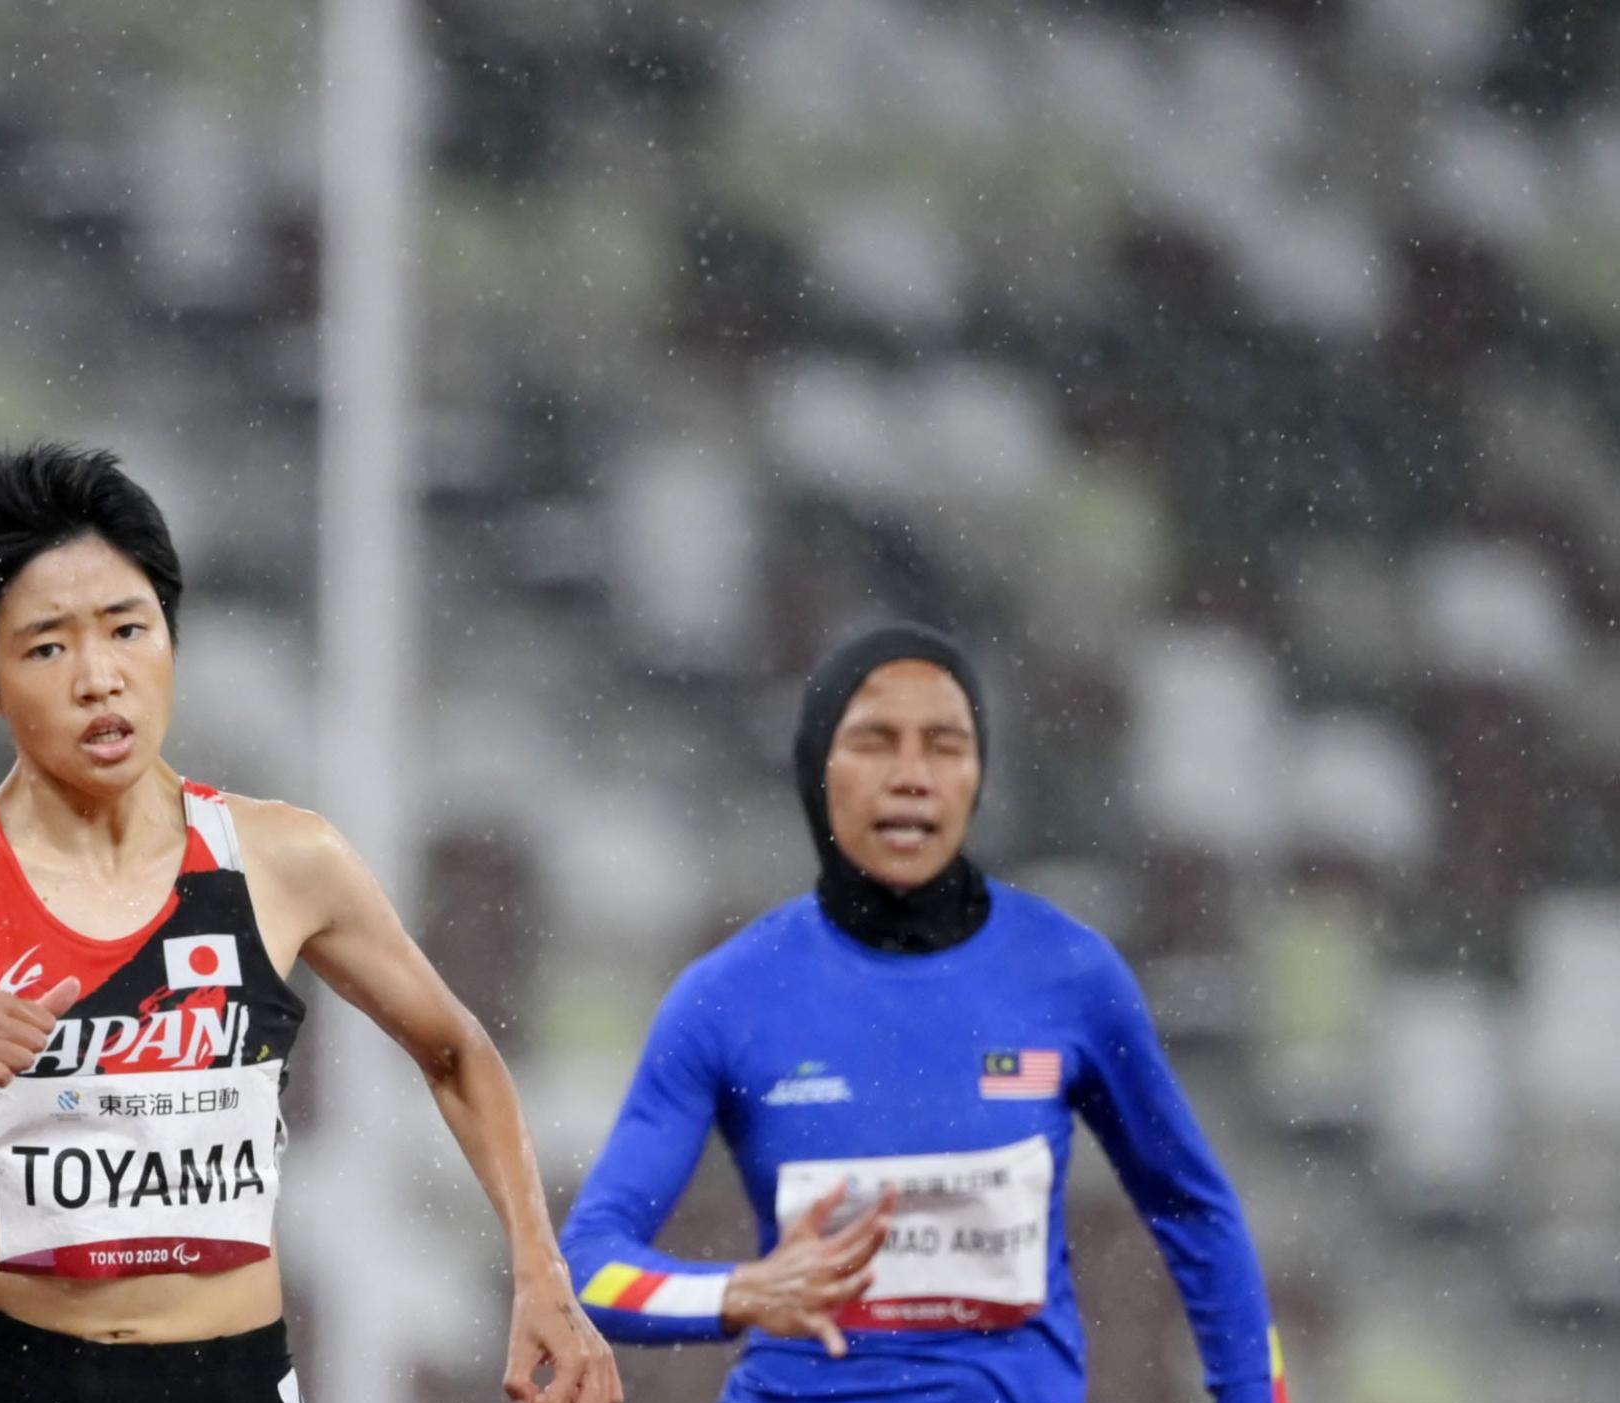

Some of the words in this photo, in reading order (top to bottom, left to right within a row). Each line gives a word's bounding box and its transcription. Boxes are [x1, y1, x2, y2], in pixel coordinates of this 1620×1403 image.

[18, 1001, 239, 1077] APAN
[98, 1088, 240, 1117] 東京海上日動
[12, 1139, 264, 1208] TOYAMA
[88, 1250, 134, 1266] TOKYO
[136, 1248, 169, 1264] 2020
